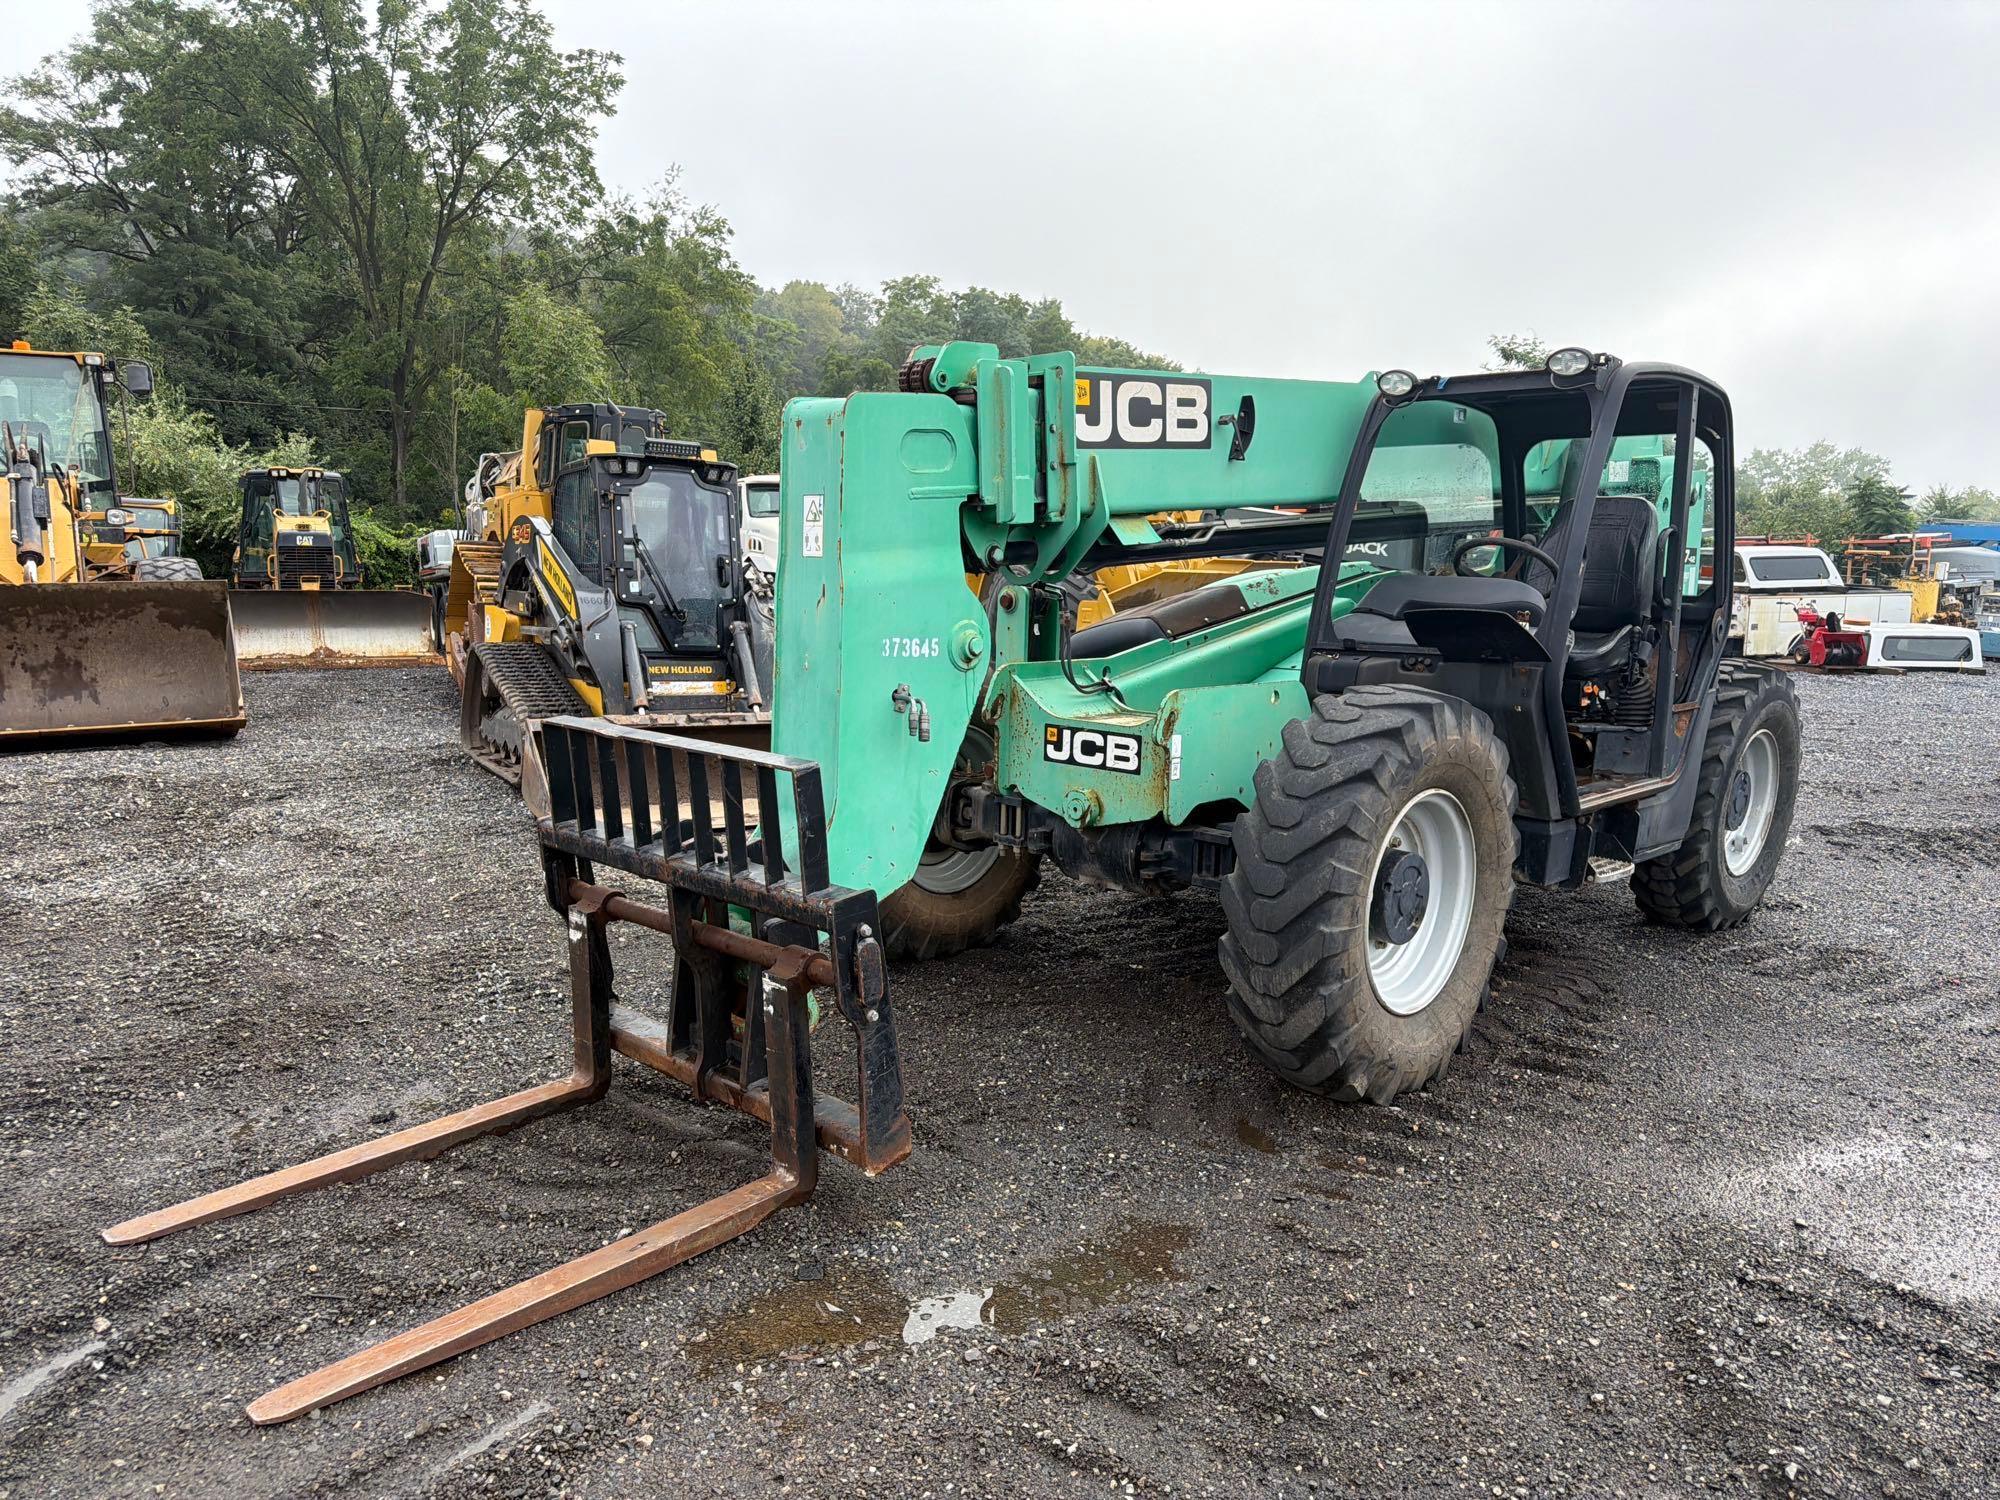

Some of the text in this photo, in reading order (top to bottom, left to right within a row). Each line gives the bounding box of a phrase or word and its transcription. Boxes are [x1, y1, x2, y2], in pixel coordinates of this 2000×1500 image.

[1076, 380, 1208, 442] JCB
[296, 535, 313, 546] CAT
[553, 570, 572, 605] HOLLAND
[882, 637, 939, 658] 373645
[648, 666, 713, 674] NEW HOLLAND
[1046, 729, 1139, 771] JCB
